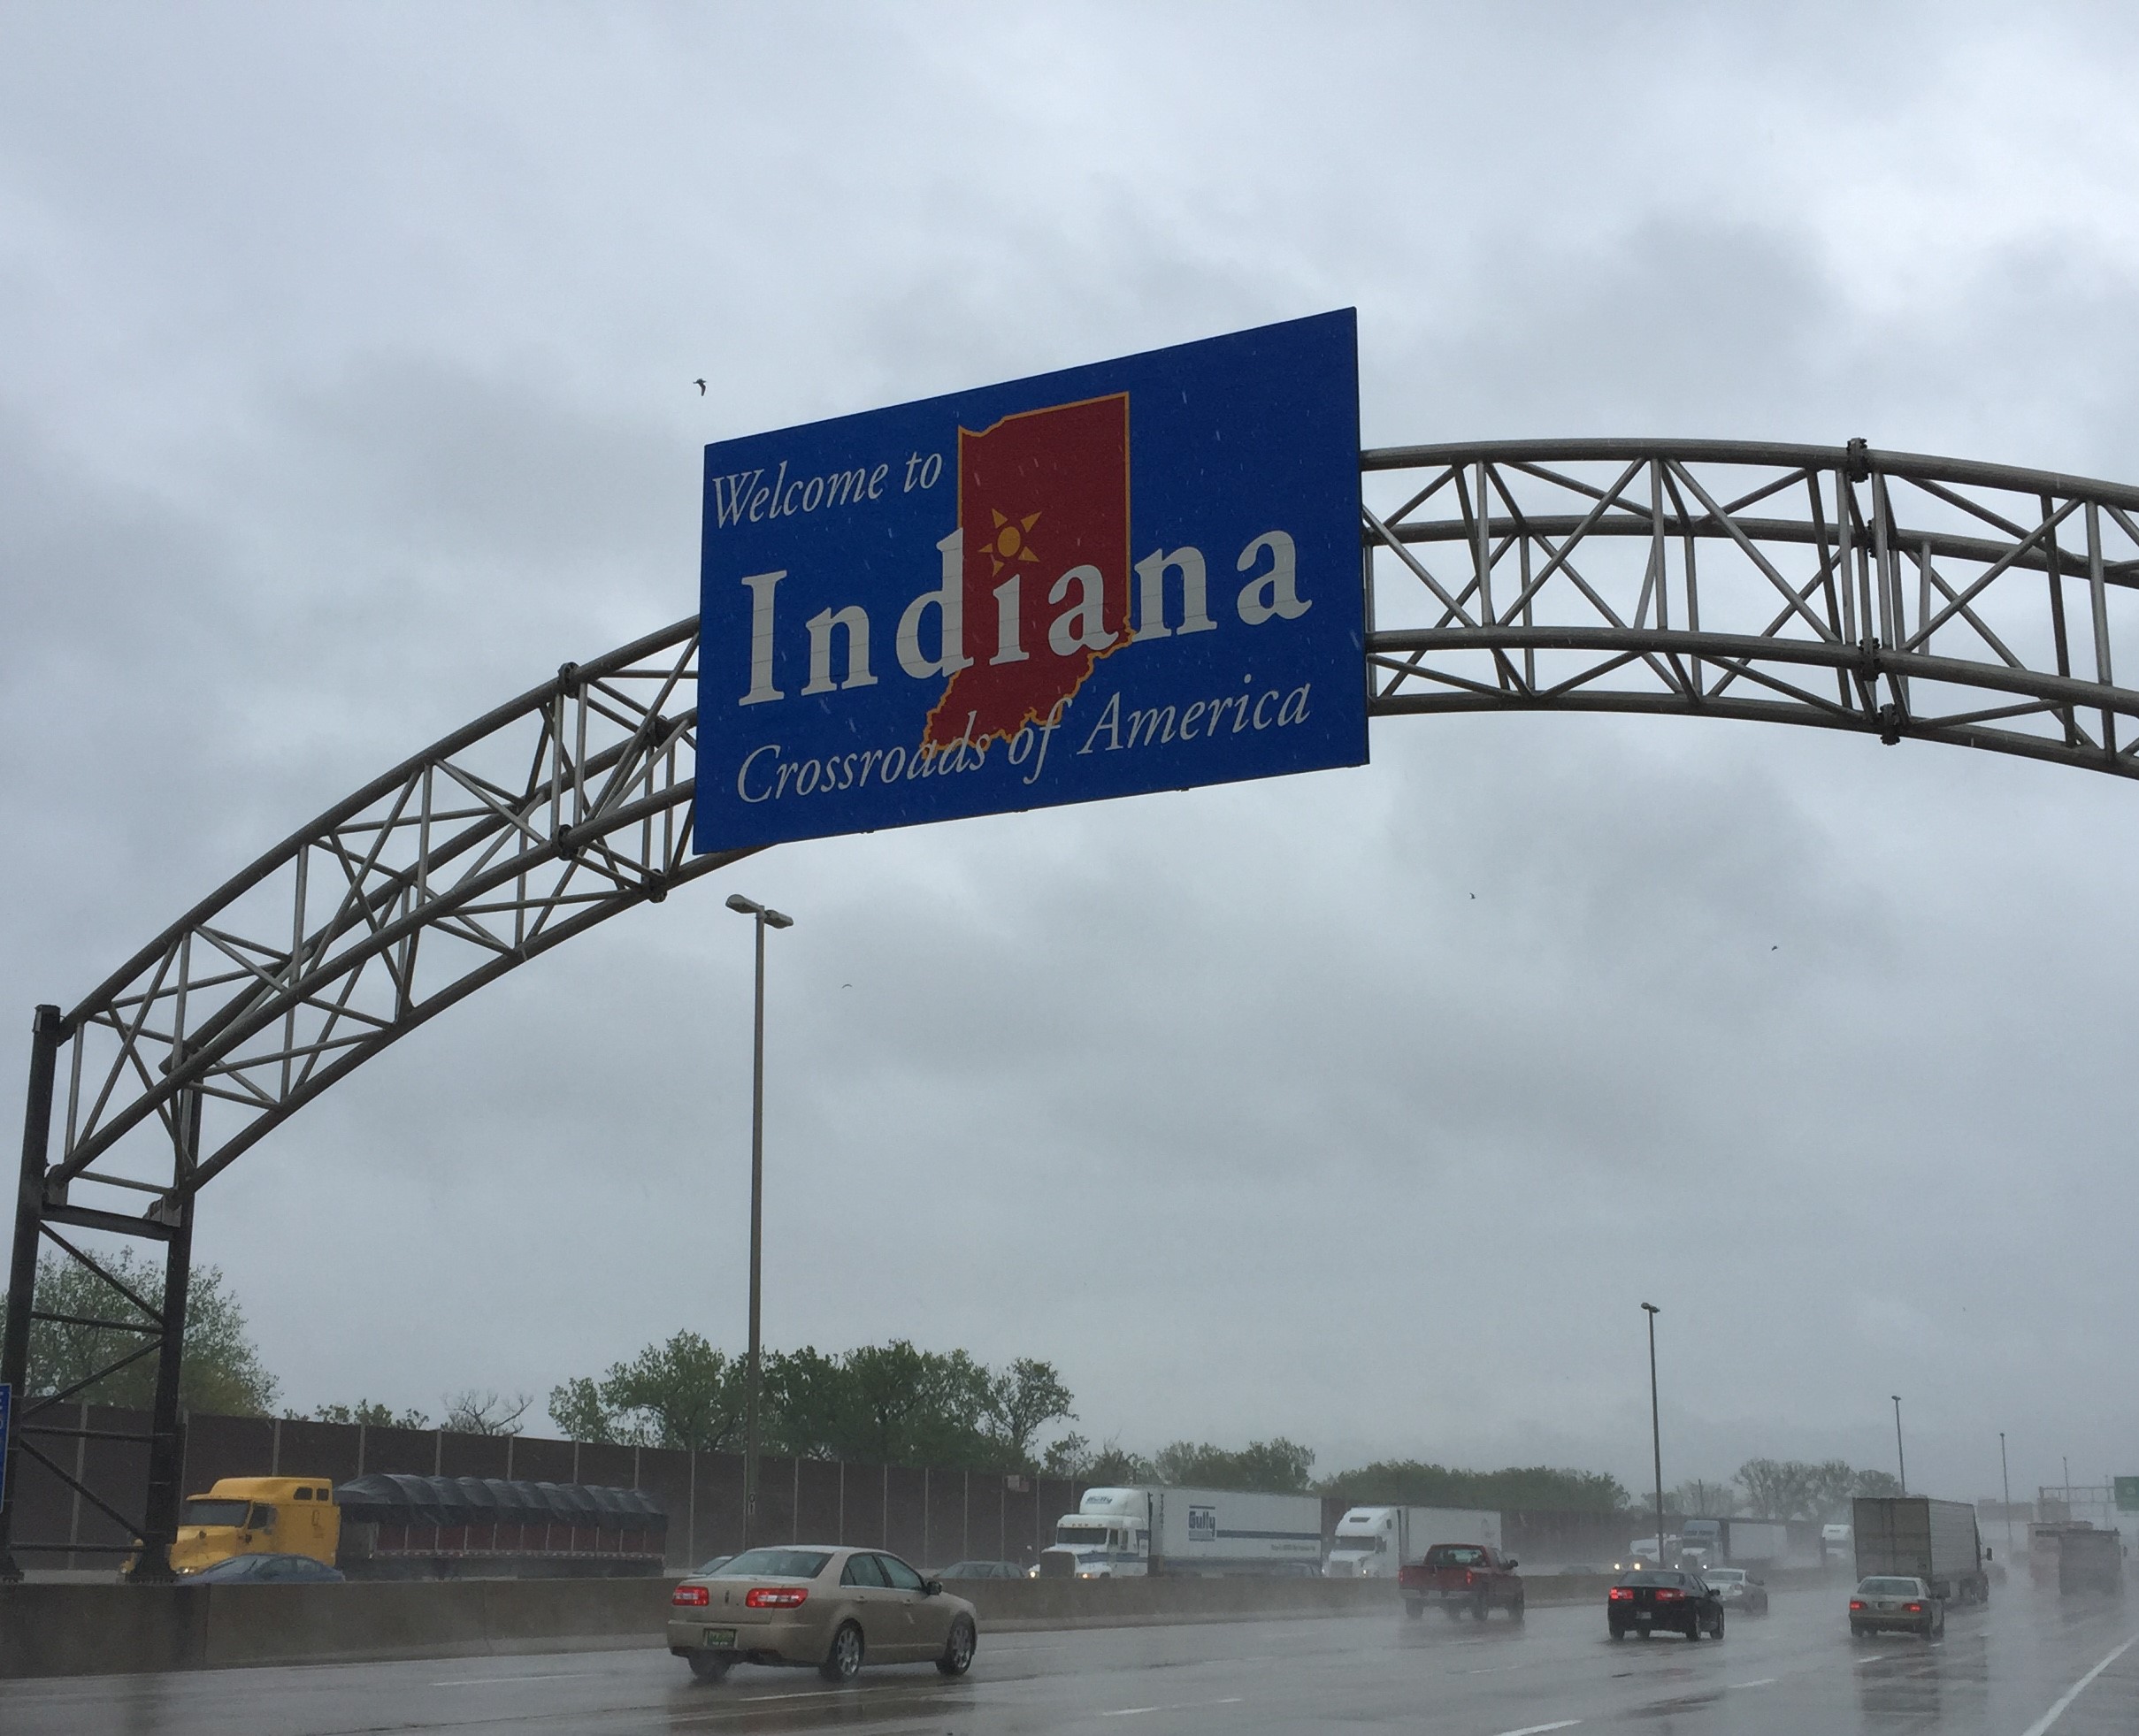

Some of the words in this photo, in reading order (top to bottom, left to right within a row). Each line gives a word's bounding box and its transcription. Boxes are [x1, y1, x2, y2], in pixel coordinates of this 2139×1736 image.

[712, 461, 886, 529] Welcome
[903, 452, 943, 492] to
[738, 527, 1313, 706] Indiana
[737, 711, 988, 803] Crossroads
[1008, 697, 1073, 785] of
[1076, 675, 1312, 755] America
